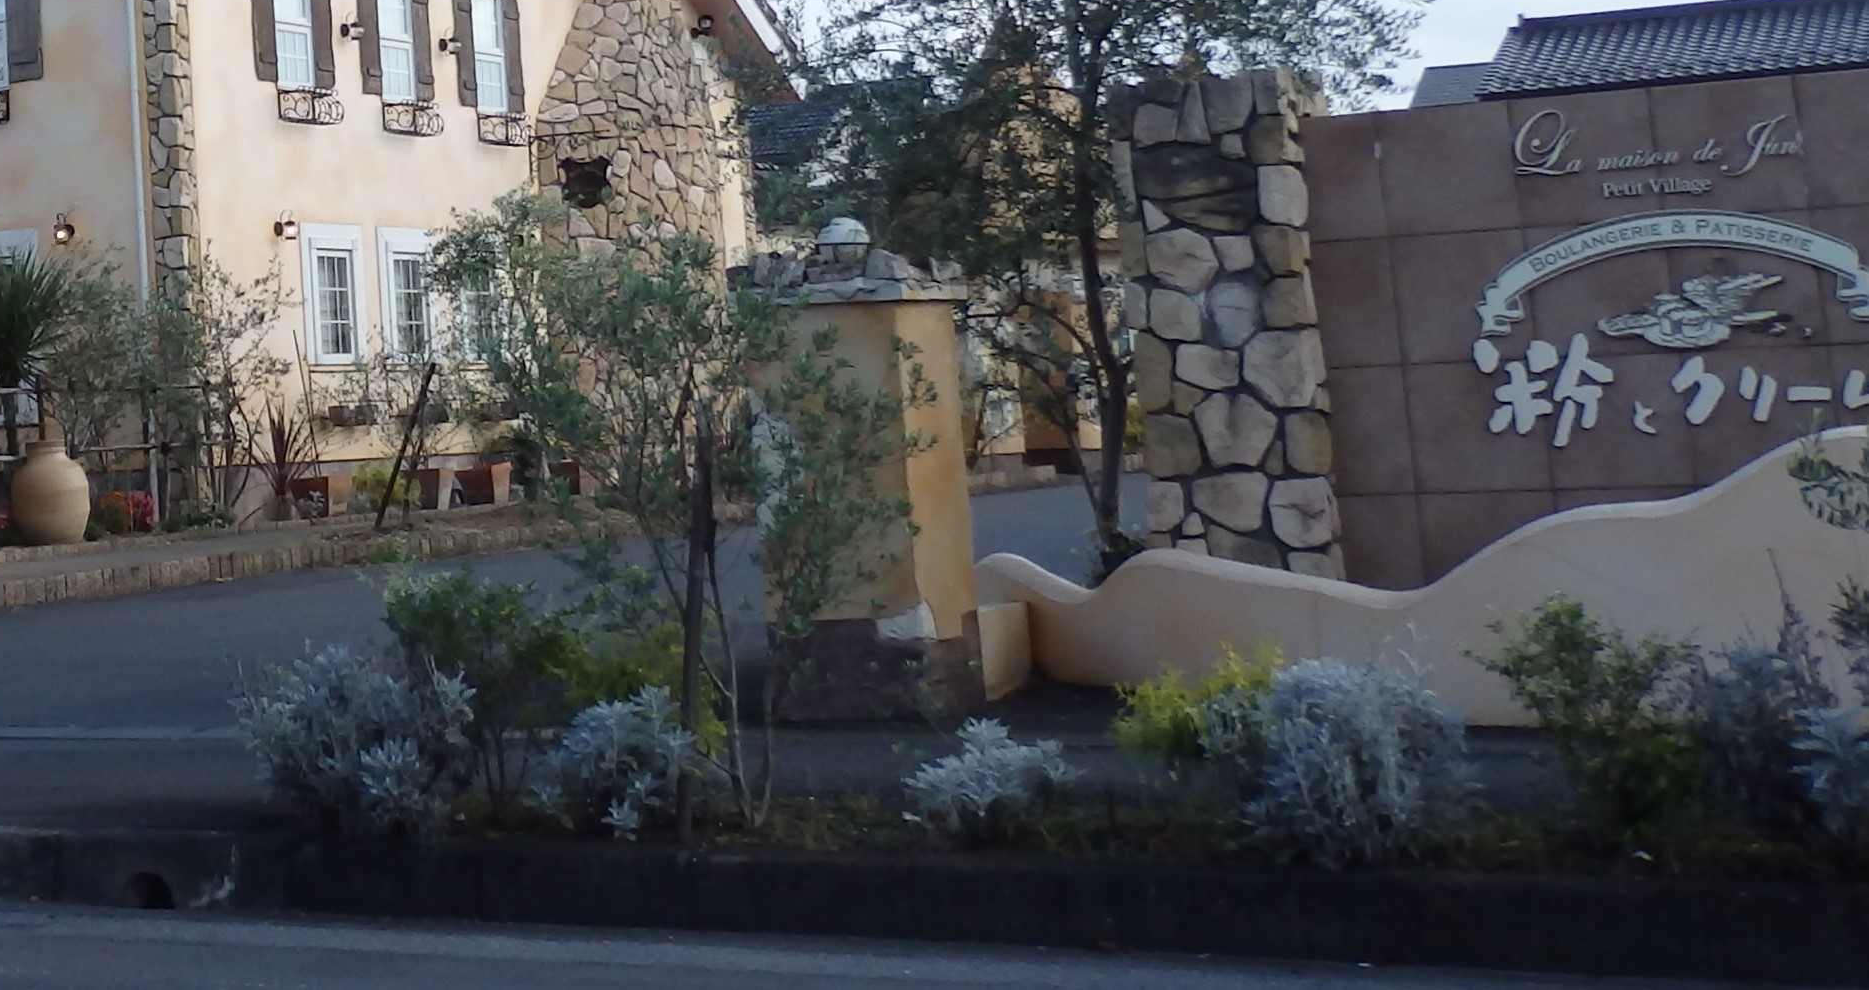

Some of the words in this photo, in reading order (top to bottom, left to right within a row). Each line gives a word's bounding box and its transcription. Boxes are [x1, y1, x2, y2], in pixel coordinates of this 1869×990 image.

[1514, 109, 1581, 175] La
[1597, 149, 1680, 172] maison
[1692, 138, 1723, 162] de
[1720, 114, 1802, 177] Jun
[1602, 181, 1643, 198] Petit
[1649, 175, 1713, 196] Village
[1671, 219, 1687, 234] &
